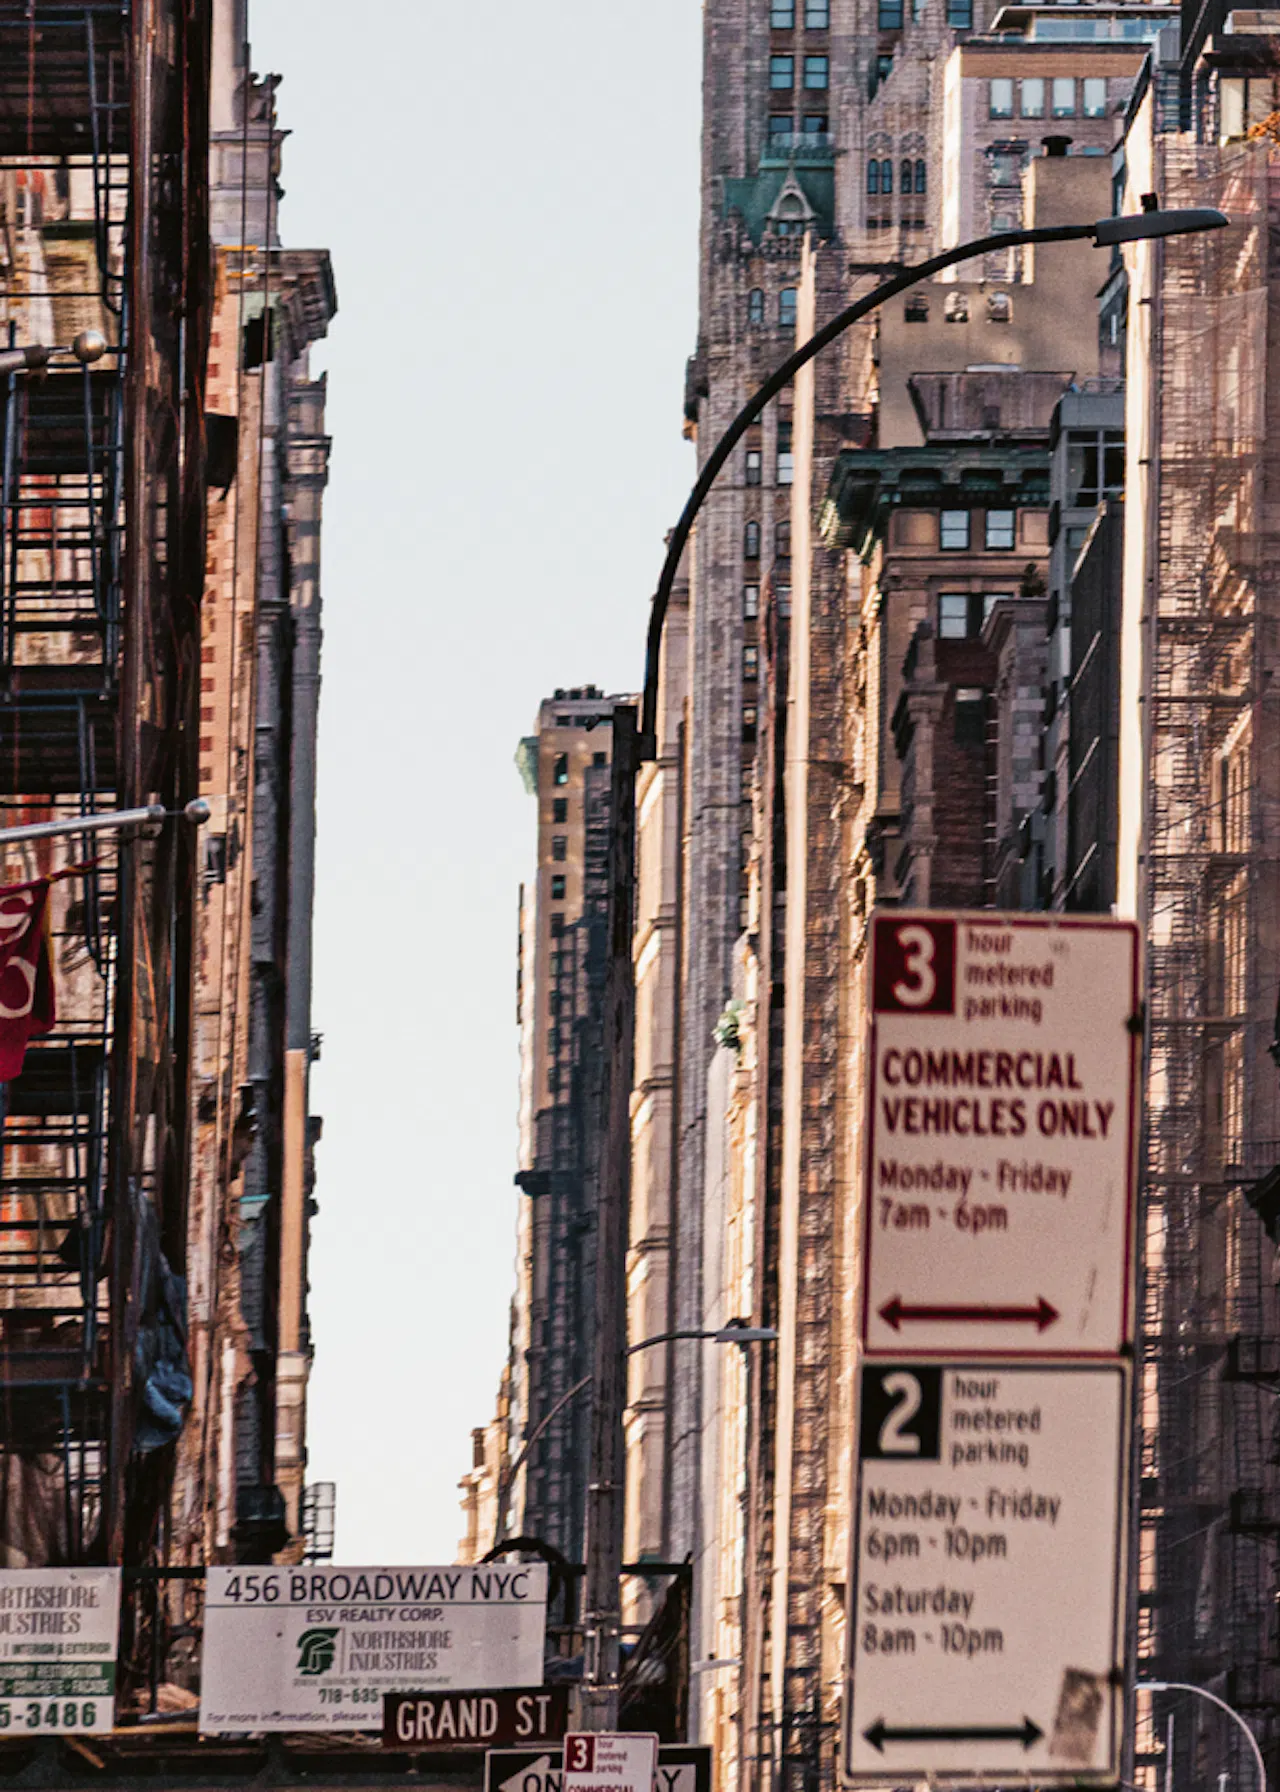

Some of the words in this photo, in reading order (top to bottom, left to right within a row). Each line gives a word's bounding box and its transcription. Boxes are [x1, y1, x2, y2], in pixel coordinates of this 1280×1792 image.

[966, 931, 1014, 954] hour
[891, 924, 936, 1008] 3
[965, 963, 1055, 987] metered
[964, 995, 1042, 1024] parking
[882, 1047, 1084, 1091] COMMERCIAL
[881, 1095, 1027, 1138] VEHICLES
[1037, 1099, 1115, 1140] ONLY
[878, 1159, 972, 1197] Monday
[997, 1159, 1072, 1199] Friday
[878, 1197, 930, 1231] 7am
[954, 1200, 1008, 1236] 6pm
[952, 1376, 1000, 1400] hour
[877, 1371, 923, 1454] 2
[950, 1406, 1042, 1433] metered
[951, 1440, 1029, 1468] parking
[867, 1489, 961, 1525] Monday
[985, 1489, 1061, 1526] Friday
[866, 1530, 920, 1562] 6pm
[943, 1529, 1008, 1561] 10pm
[225, 1574, 280, 1603] 456
[289, 1573, 461, 1602] BROADWAY
[472, 1571, 529, 1600] NYC
[863, 1583, 974, 1619] Saturday
[306, 1608, 336, 1622] ESV
[339, 1608, 397, 1622] REALTY
[400, 1608, 445, 1622] CORP.
[350, 1630, 453, 1650] NORTHSHORE
[861, 1625, 916, 1654] 8am
[940, 1623, 1004, 1659] 10pm
[348, 1652, 438, 1672] INDUSTRIES
[396, 1697, 499, 1741] GRAND
[515, 1694, 552, 1736] ST
[571, 1737, 589, 1770] 3
